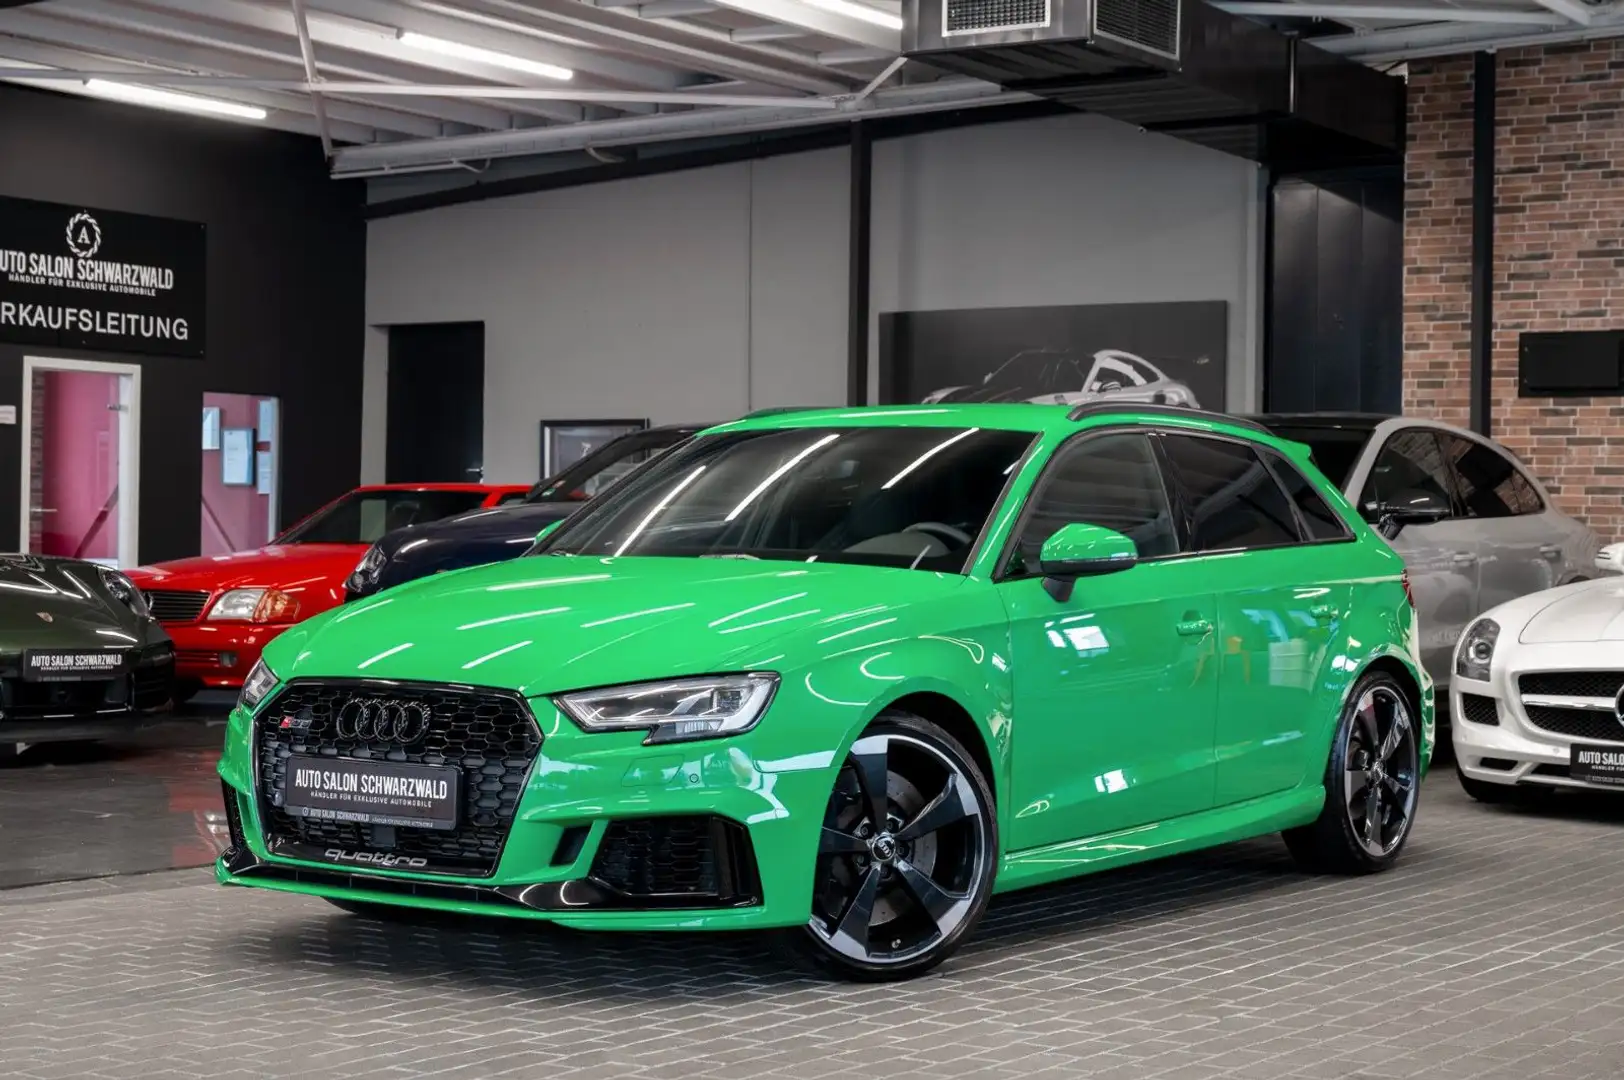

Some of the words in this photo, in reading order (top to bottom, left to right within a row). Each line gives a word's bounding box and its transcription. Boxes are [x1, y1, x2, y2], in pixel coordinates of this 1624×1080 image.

[77, 226, 91, 244] A
[29, 252, 74, 279] SALON
[77, 258, 173, 290] SCHWARZWALD
[8, 273, 46, 285] HÄNDLER
[48, 276, 64, 287] FÜR
[66, 279, 107, 292] EXKLUSIVE
[109, 284, 156, 297] AUTOMOBILE
[31, 655, 49, 667] AUTO
[51, 655, 74, 666] SALON
[75, 654, 122, 666] SCHWARZWALD
[1578, 750, 1600, 764] AUTO
[295, 769, 321, 789] AUTO
[323, 771, 358, 792] SALON
[361, 774, 447, 799] SCHWARZWALD
[310, 790, 337, 800] HÄNDLER
[353, 794, 388, 804] EXKLUSIVE
[390, 798, 432, 808] AUTOMOBILE
[324, 848, 428, 867] quattro
